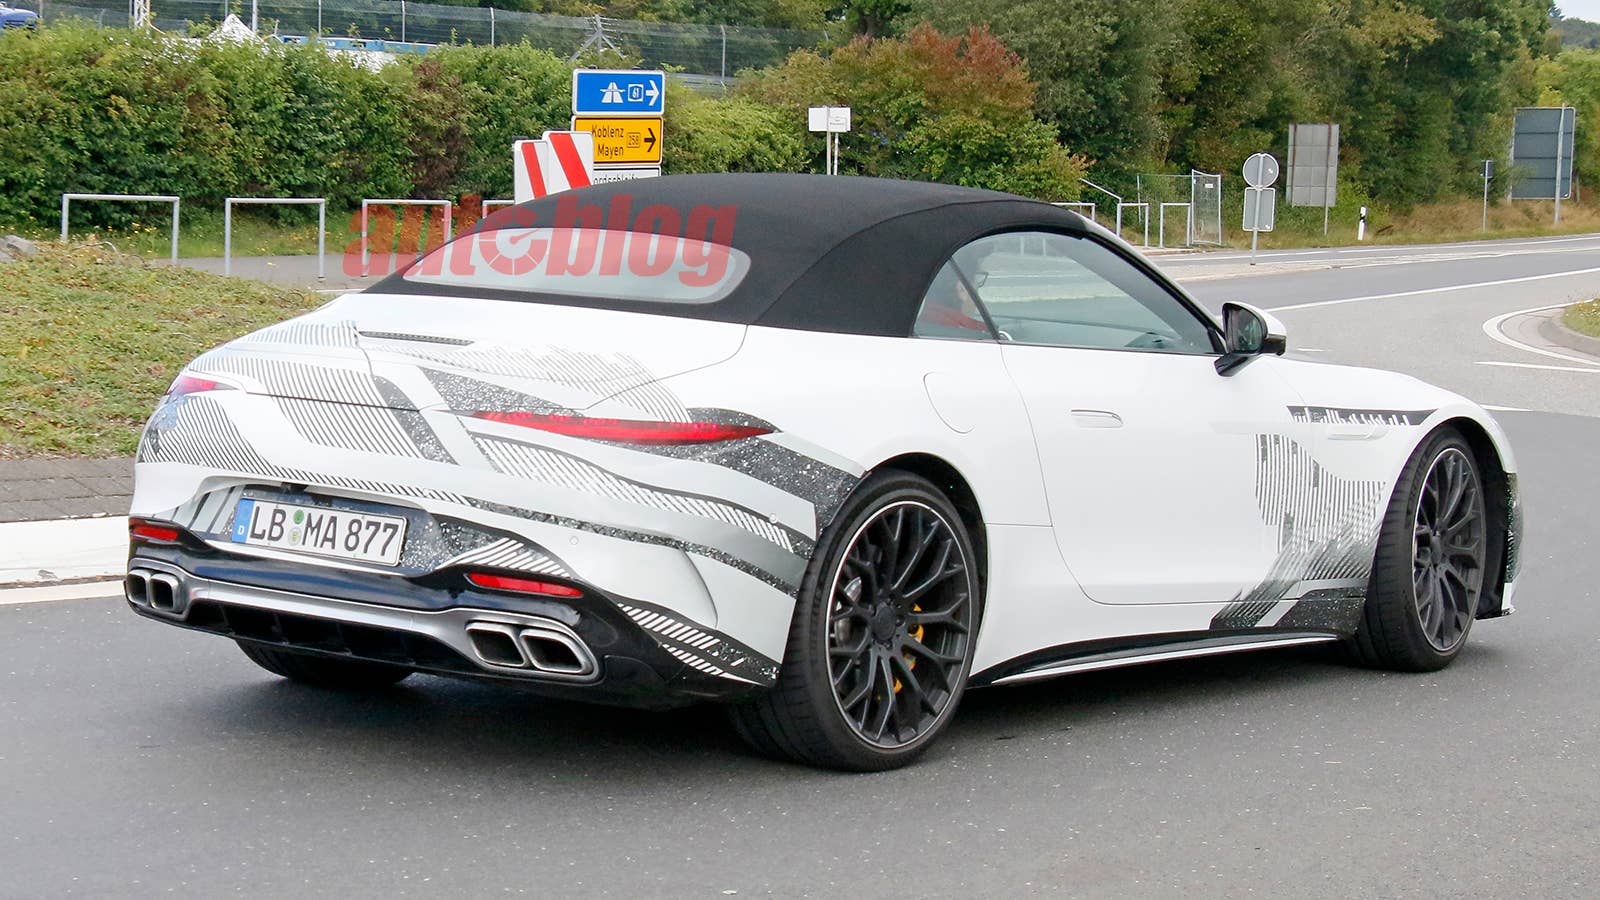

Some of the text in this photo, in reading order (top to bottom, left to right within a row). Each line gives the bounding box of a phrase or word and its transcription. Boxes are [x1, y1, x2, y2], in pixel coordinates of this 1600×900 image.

[632, 87, 640, 98] 61
[591, 124, 624, 138] Koblenz
[628, 135, 639, 146] 258
[597, 144, 624, 159] Mayen
[237, 525, 245, 536] D
[250, 506, 399, 557] LB MA 877
